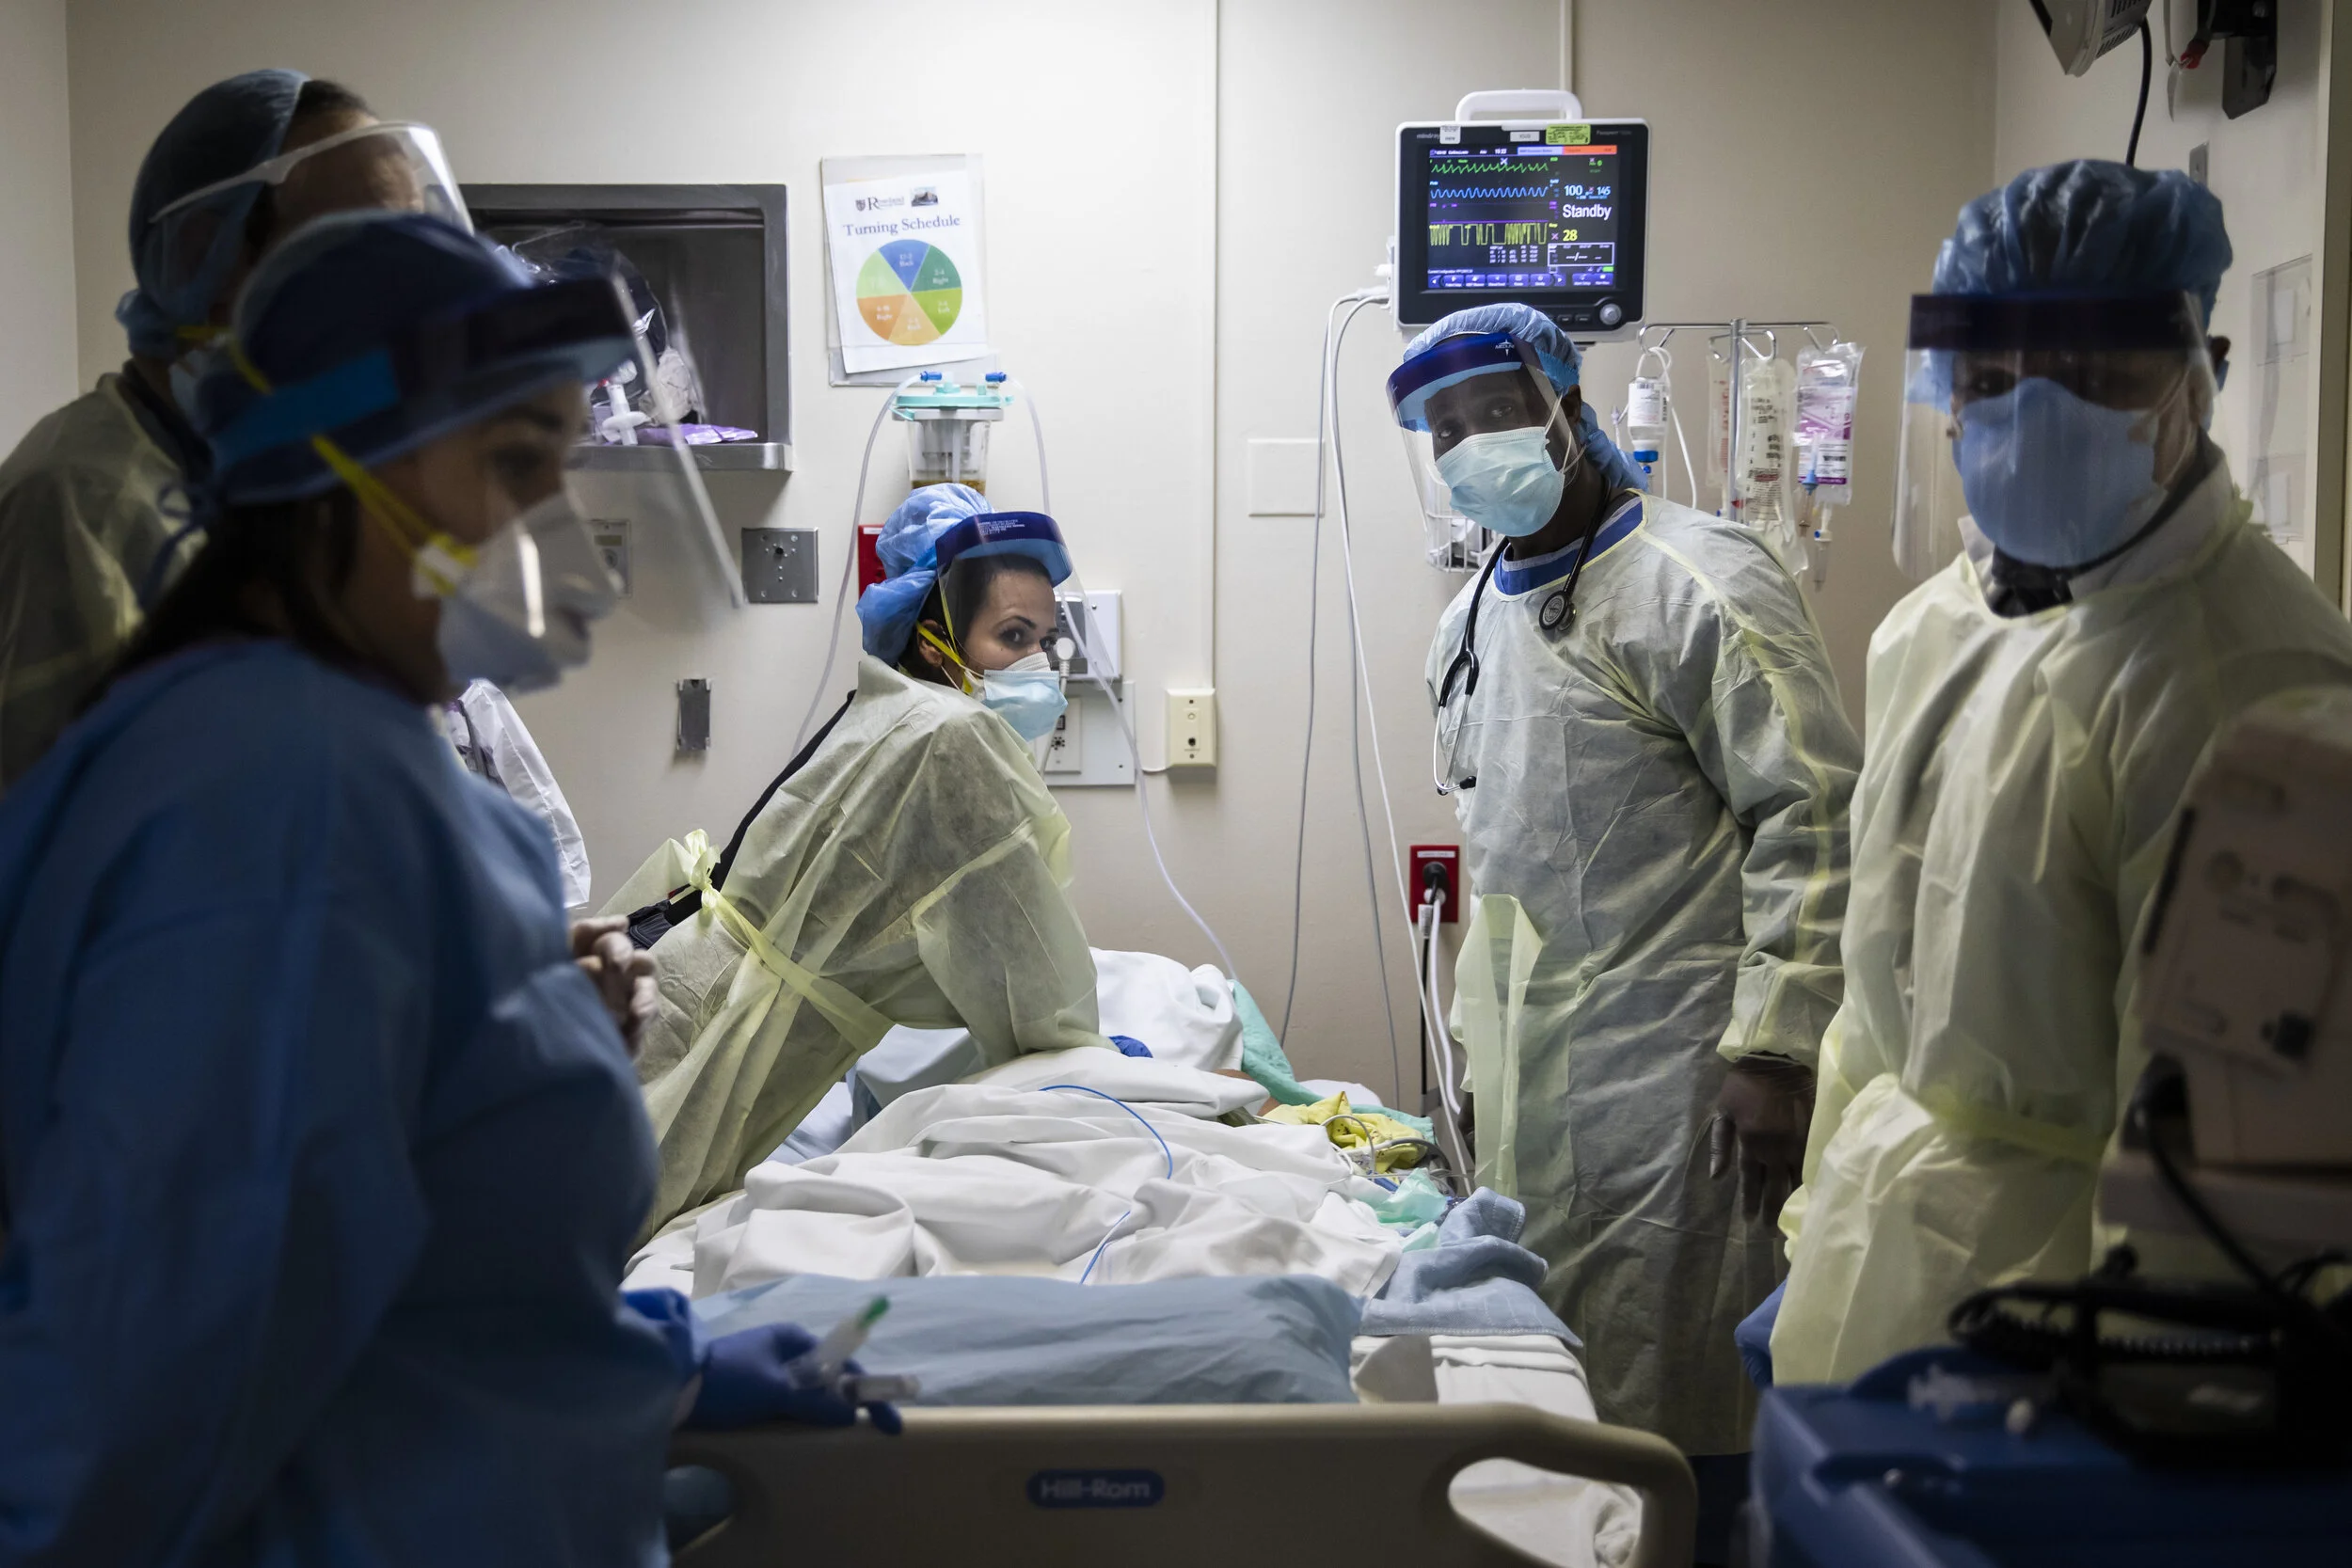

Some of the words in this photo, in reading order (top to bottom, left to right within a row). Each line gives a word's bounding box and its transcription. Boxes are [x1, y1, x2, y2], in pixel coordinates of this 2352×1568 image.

[1564, 185, 1583, 197] 100
[1562, 203, 1613, 221] Standby
[844, 222, 898, 236] Turning
[901, 214, 961, 231] Schedule
[1563, 229, 1578, 242] 28
[1041, 1478, 1151, 1499] Hill-Rom
